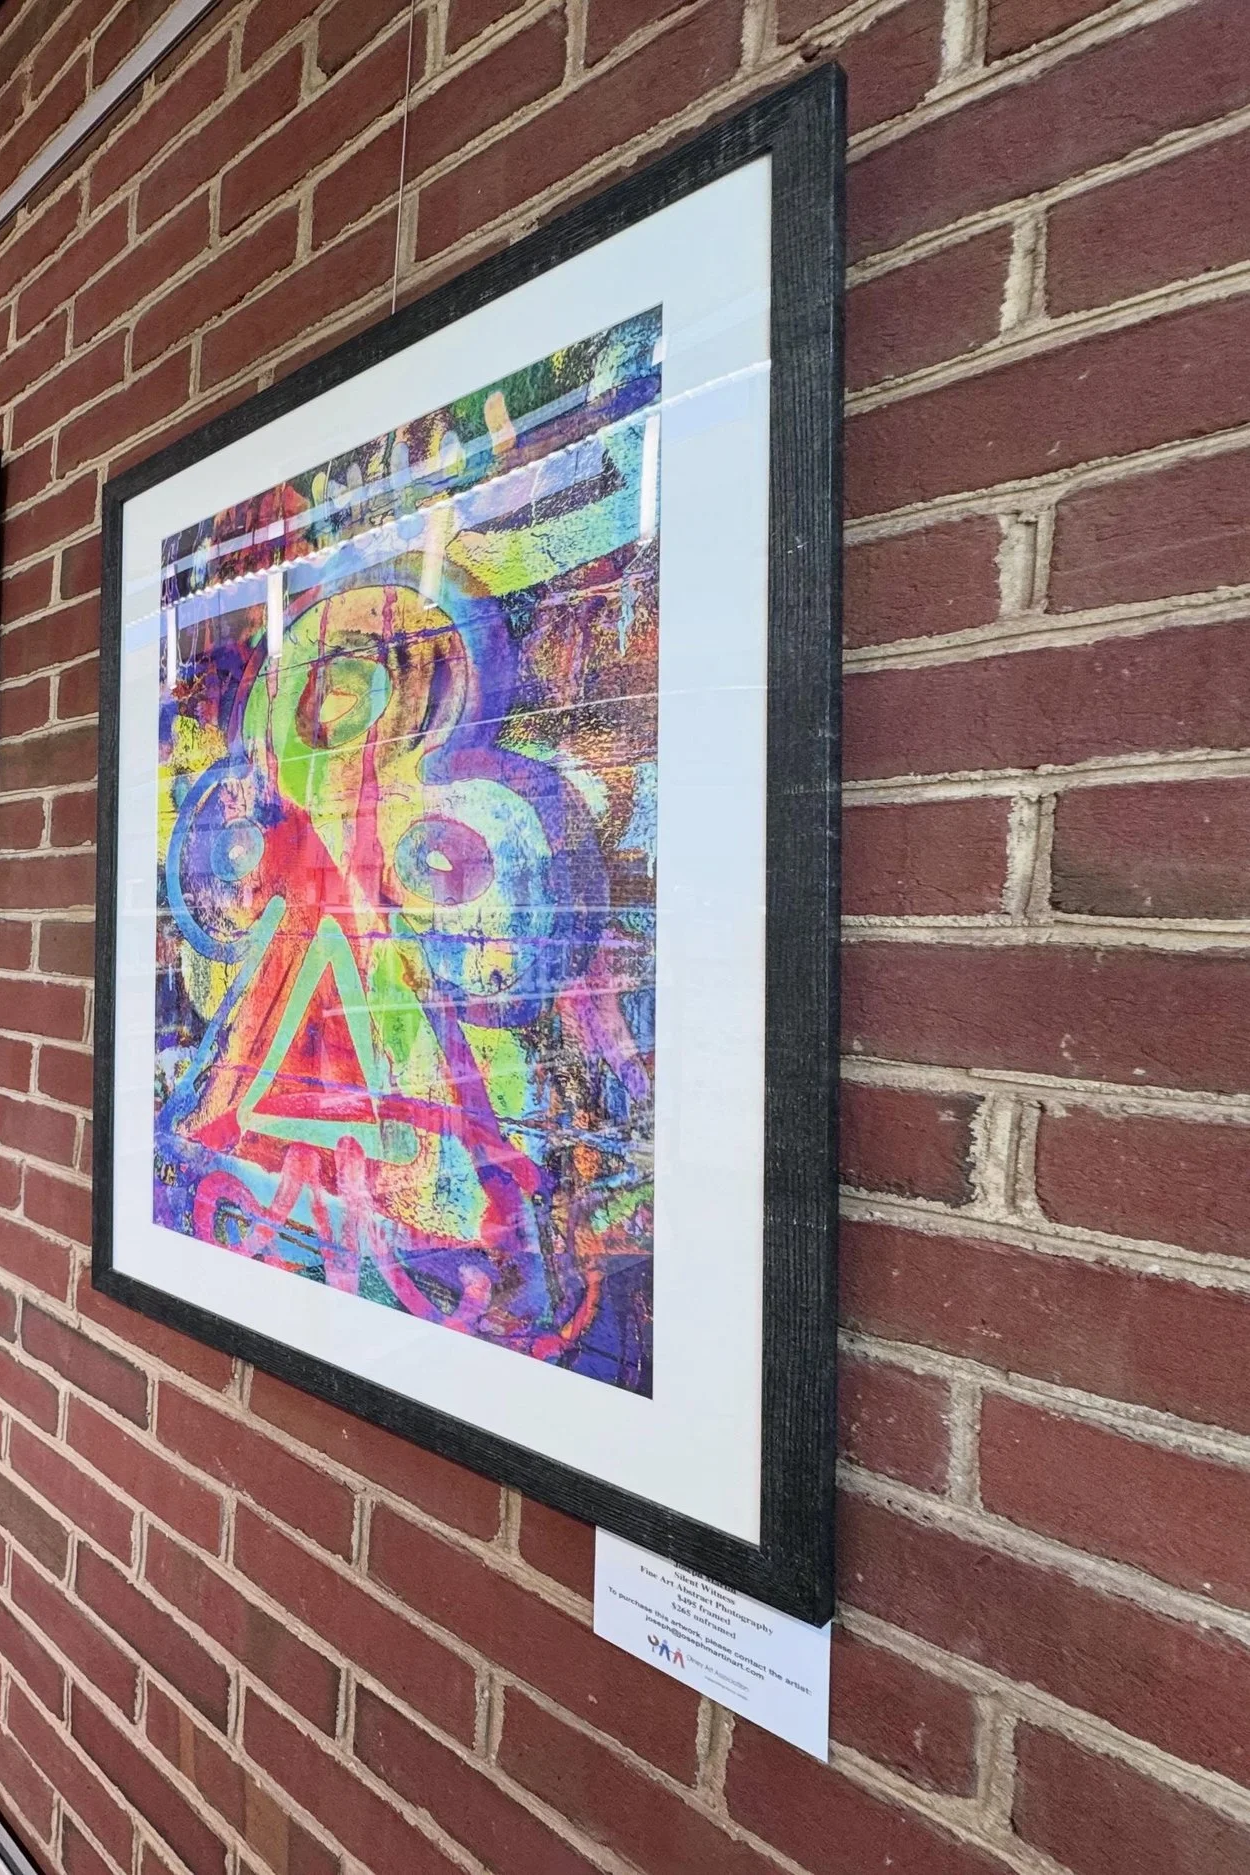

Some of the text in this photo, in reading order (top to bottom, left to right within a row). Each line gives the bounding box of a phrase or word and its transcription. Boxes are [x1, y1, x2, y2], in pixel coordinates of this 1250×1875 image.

[640, 1565, 774, 1636] Fine Art Abstract Photography
[674, 1571, 736, 1605] Silent Witness
[608, 1586, 812, 1697] To purchase this artwork, please contact the artist:
[671, 1602, 736, 1640] $265 unframed
[699, 1605, 731, 1626] framed
[645, 1614, 765, 1681] joseph@josephmartinart.com
